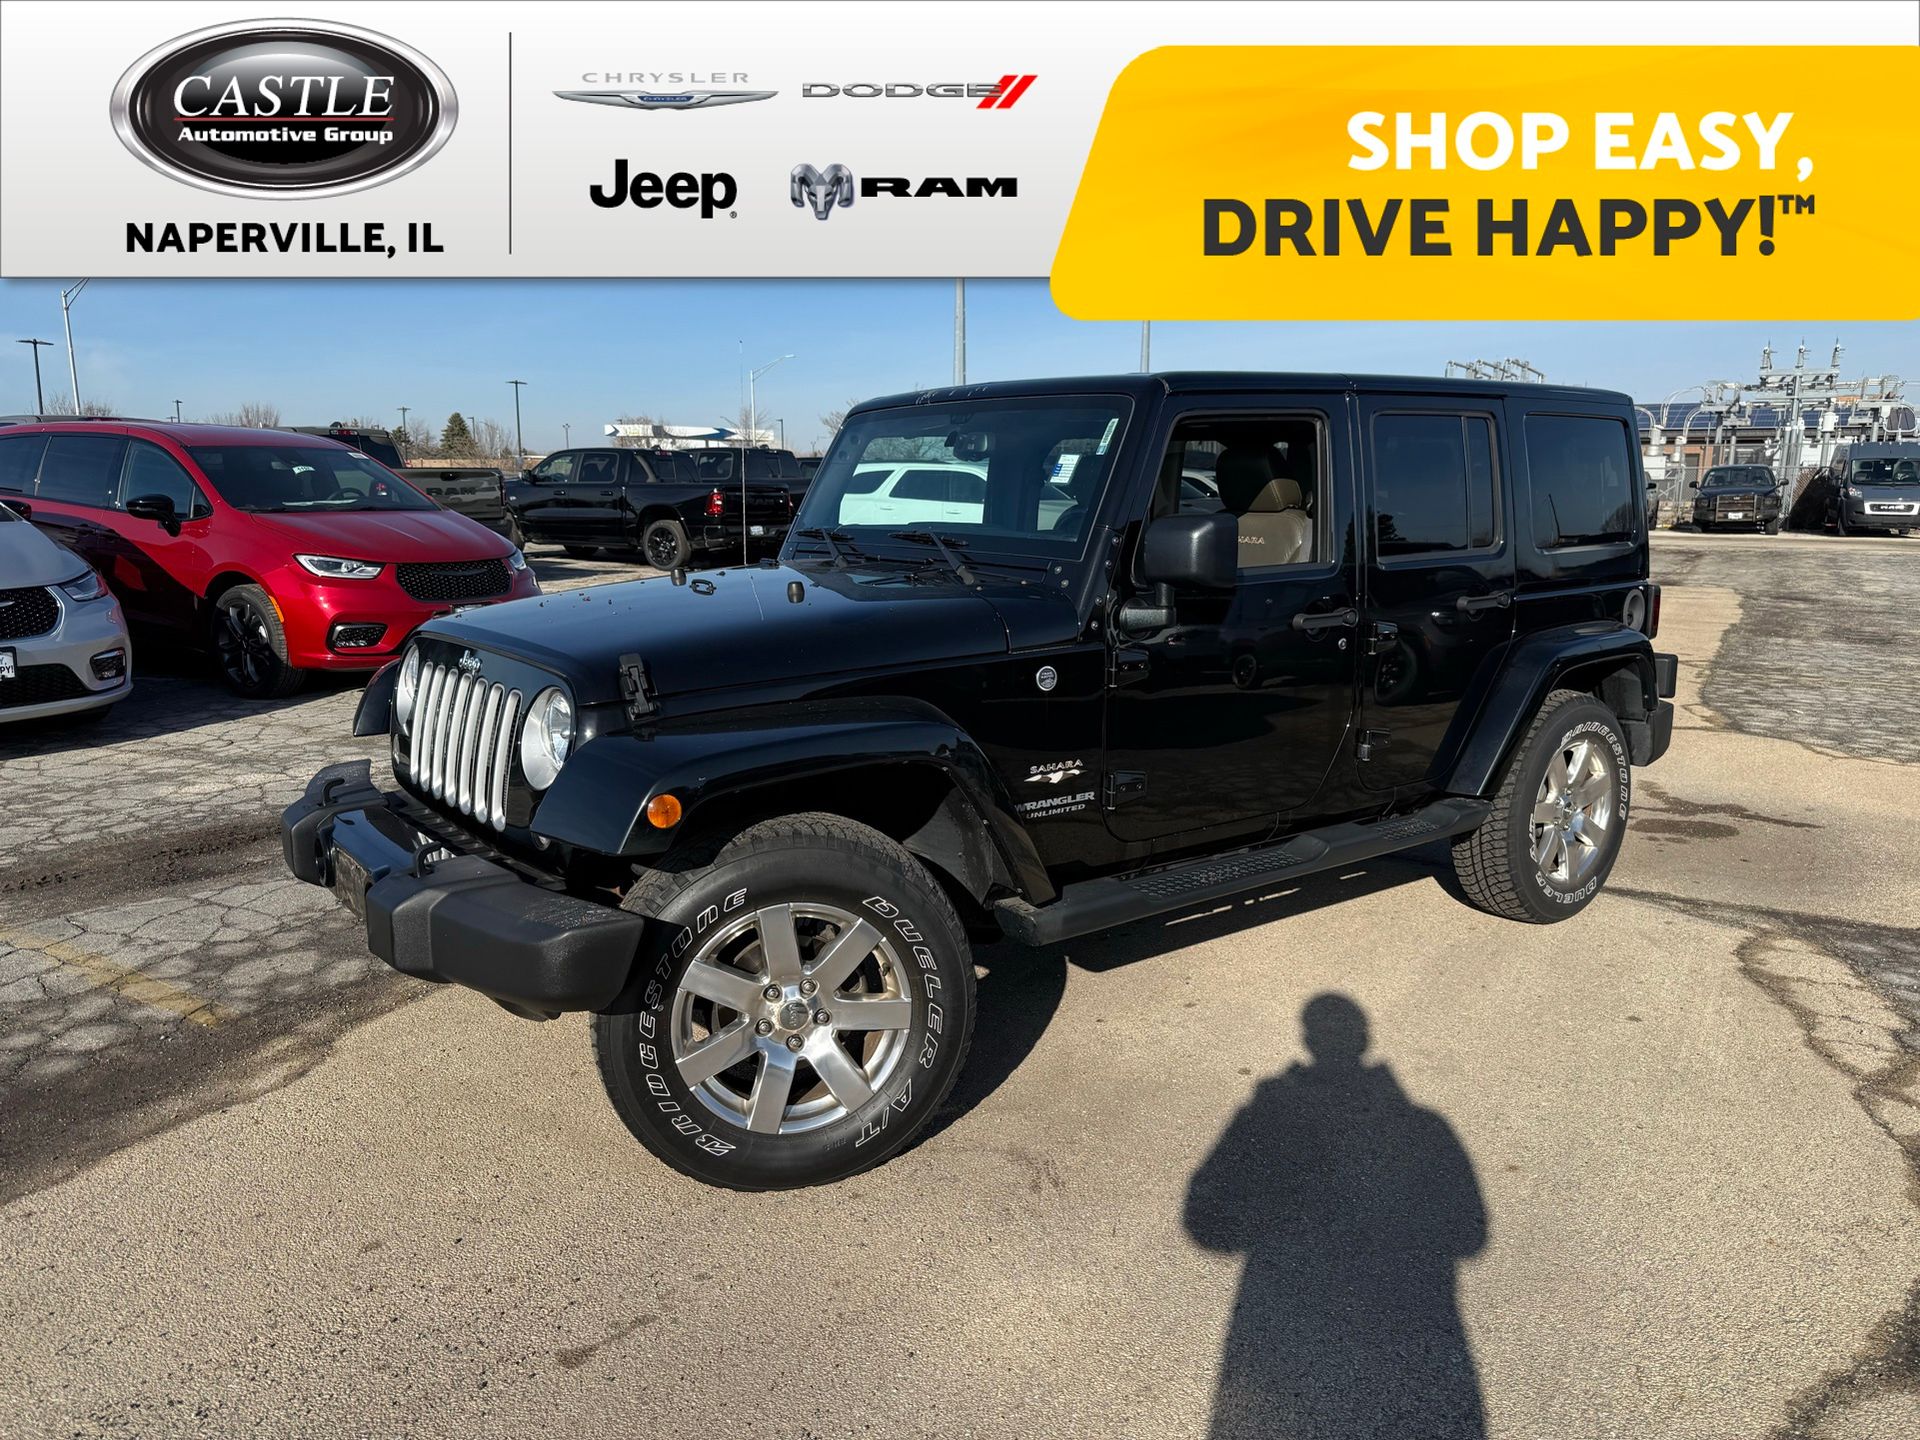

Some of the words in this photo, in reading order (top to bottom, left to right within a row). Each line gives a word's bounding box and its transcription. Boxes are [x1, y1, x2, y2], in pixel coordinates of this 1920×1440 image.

[425, 487, 475, 495] RAM
[459, 650, 481, 676] Jeep
[1030, 759, 1083, 774] SAHARA
[1014, 791, 1095, 813] WRANGLER
[1026, 803, 1086, 819] UNLIMITED
[862, 896, 944, 1069] DUELER
[639, 887, 748, 1157] BRIDGESTONE
[855, 1078, 913, 1148] A/T
